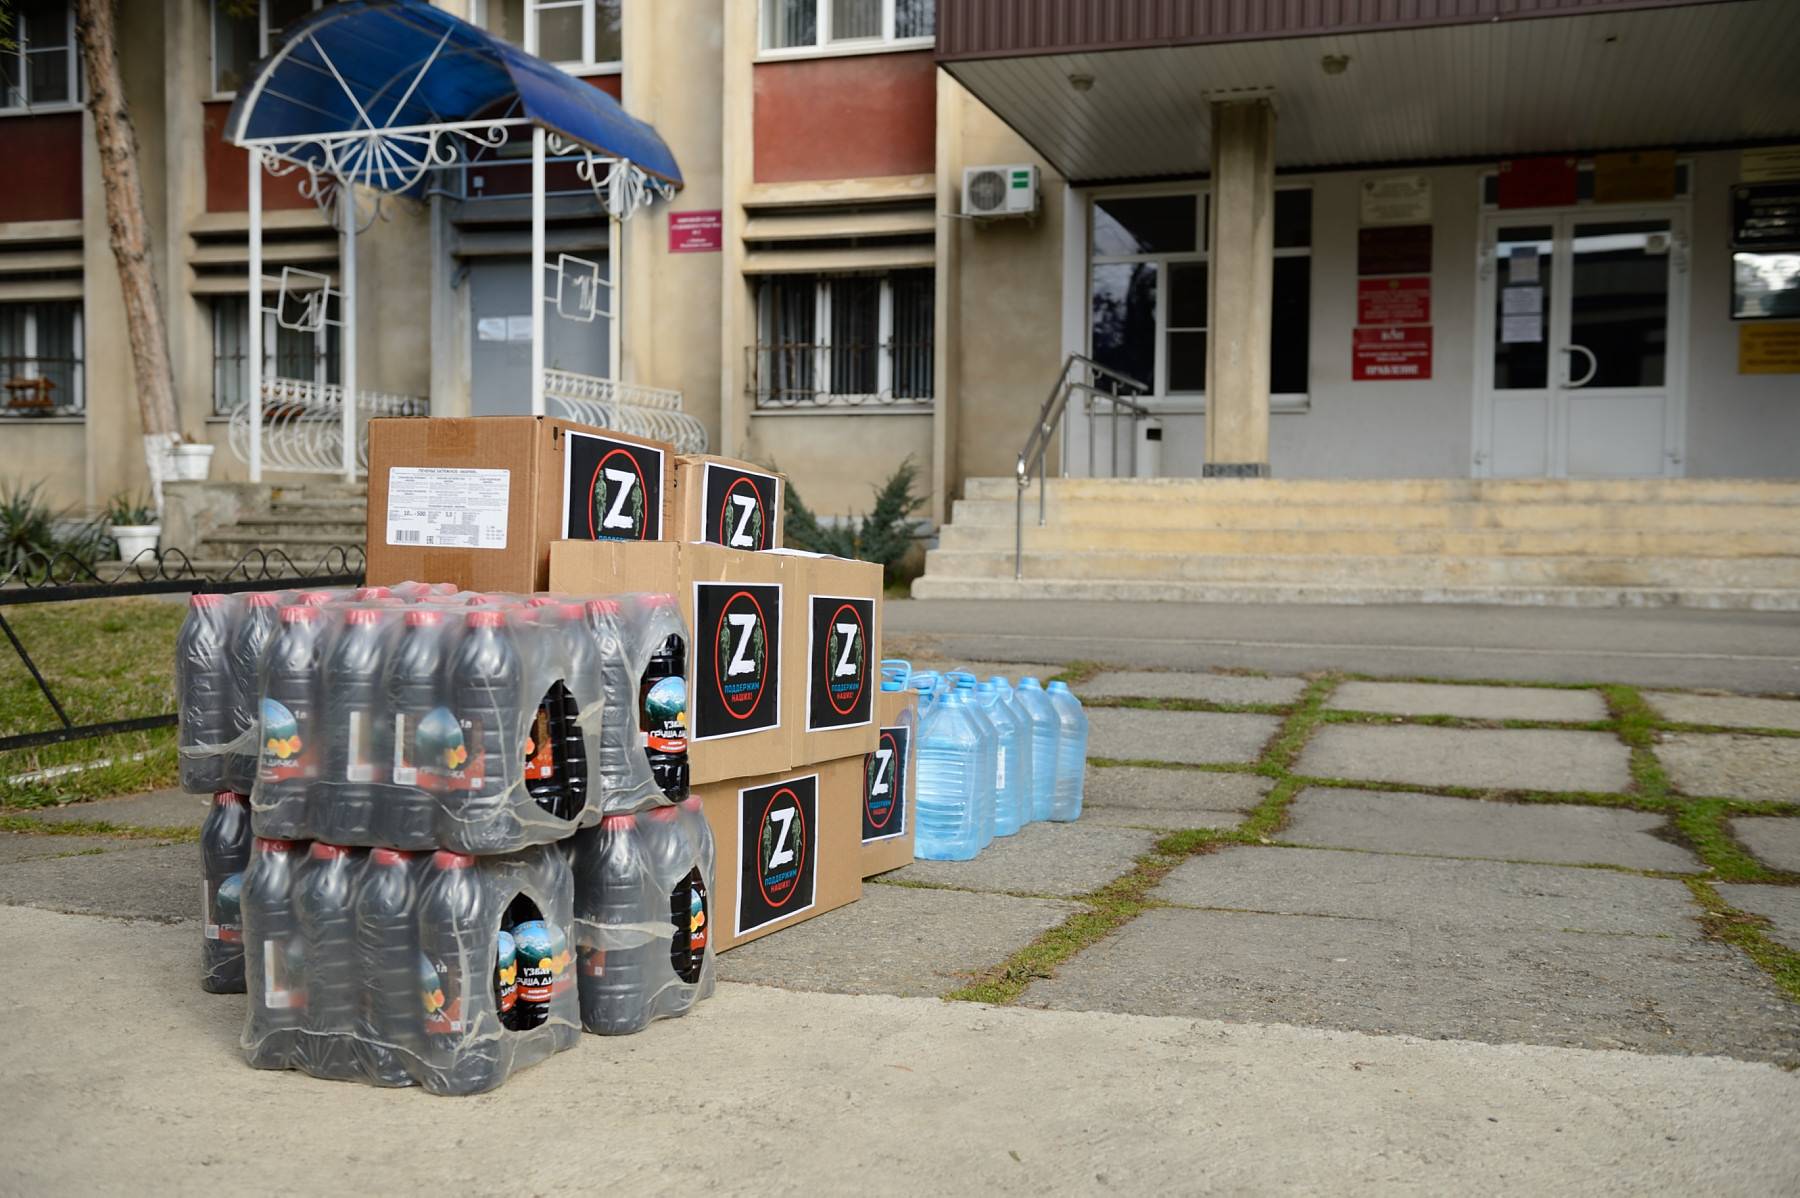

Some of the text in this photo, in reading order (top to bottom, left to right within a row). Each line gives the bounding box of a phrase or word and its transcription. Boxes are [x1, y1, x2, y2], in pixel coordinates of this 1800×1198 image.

[603, 467, 636, 529] Z
[730, 493, 756, 547] Z
[728, 613, 757, 676] Z
[835, 622, 858, 677] Z
[724, 681, 760, 694] ПОДДЕРЖИМ
[871, 749, 893, 796] Z
[768, 806, 796, 870] Z
[764, 868, 798, 887] ПОДДЕРЖИМ
